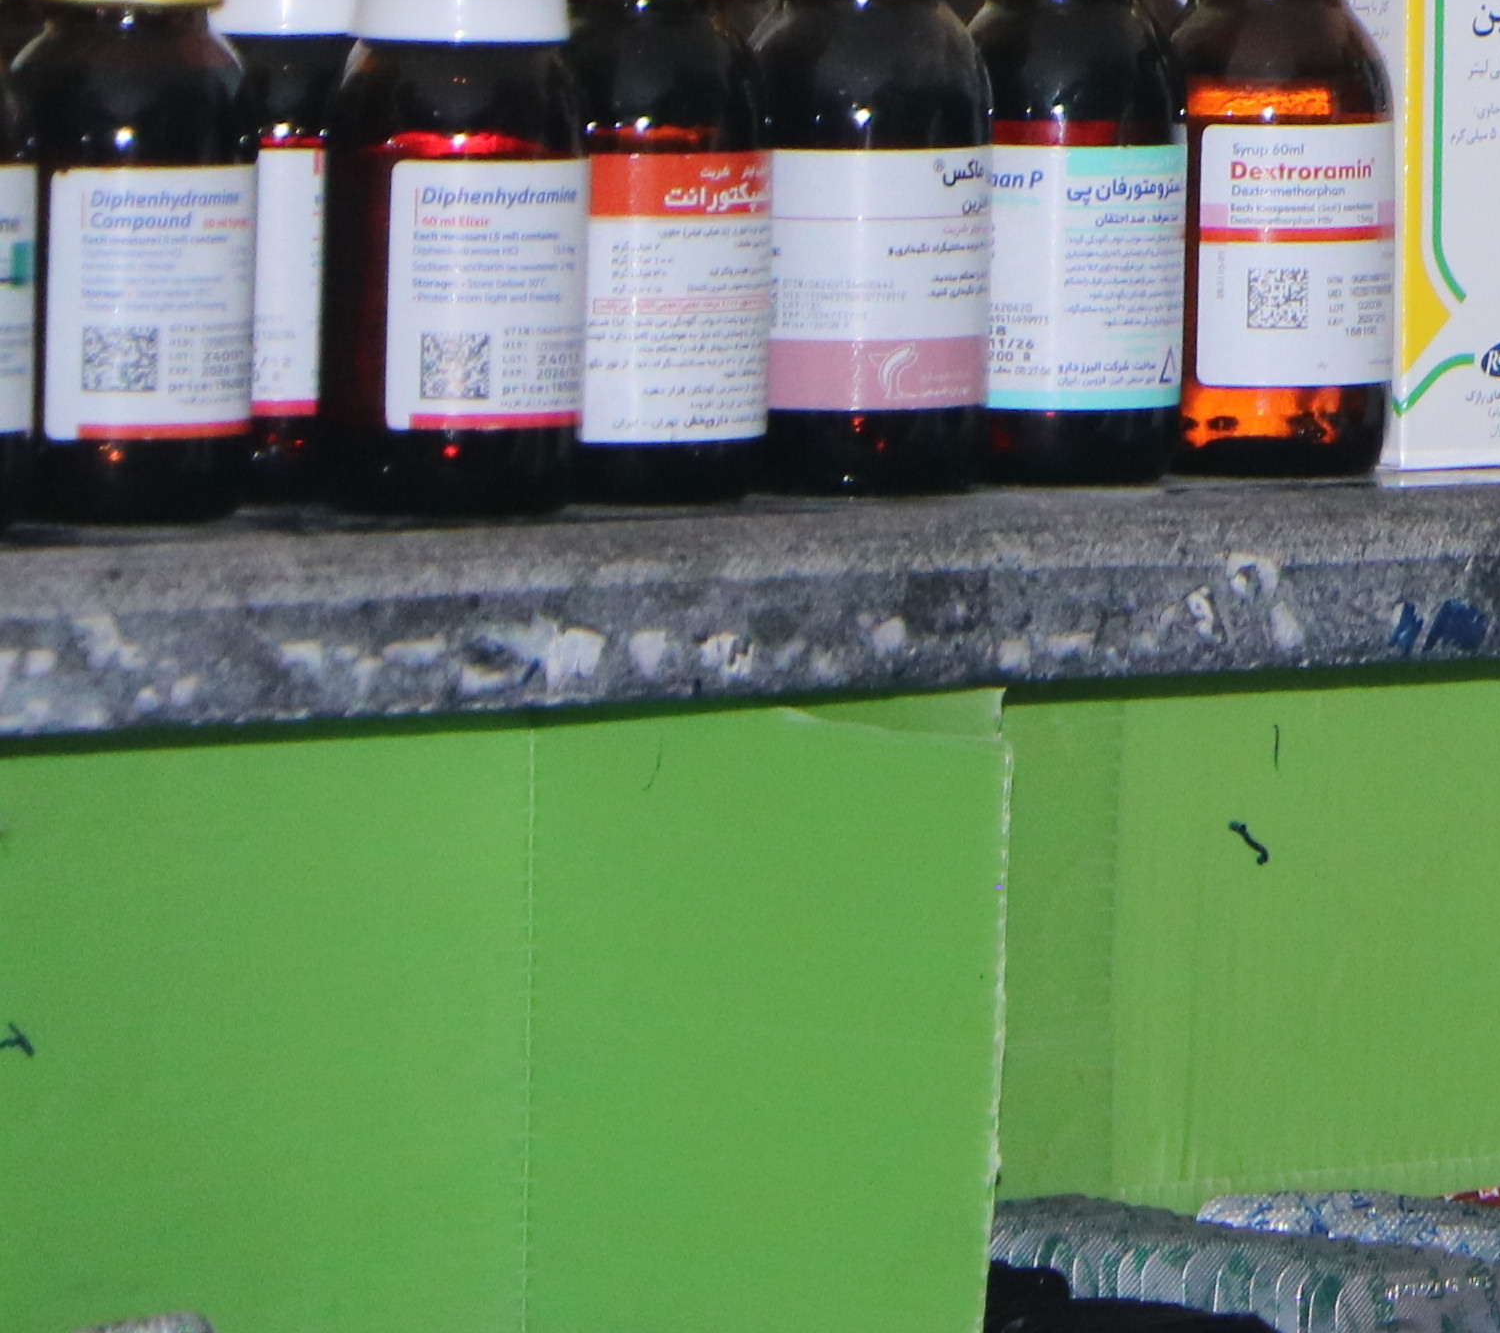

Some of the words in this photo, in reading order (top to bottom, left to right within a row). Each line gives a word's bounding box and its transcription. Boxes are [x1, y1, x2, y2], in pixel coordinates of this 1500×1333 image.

[1232, 142, 1268, 158] Syrup
[1272, 142, 1305, 156] 60ml
[1230, 158, 1373, 181] Dextroramin
[1029, 170, 1044, 190] P
[90, 190, 242, 211] Diphenhydramine
[421, 186, 578, 209] Diphenhydramine
[1066, 185, 1093, 206] پی
[1231, 184, 1346, 200] Dextromethorphan
[90, 211, 193, 231] Compound
[458, 215, 490, 228] Elixir
